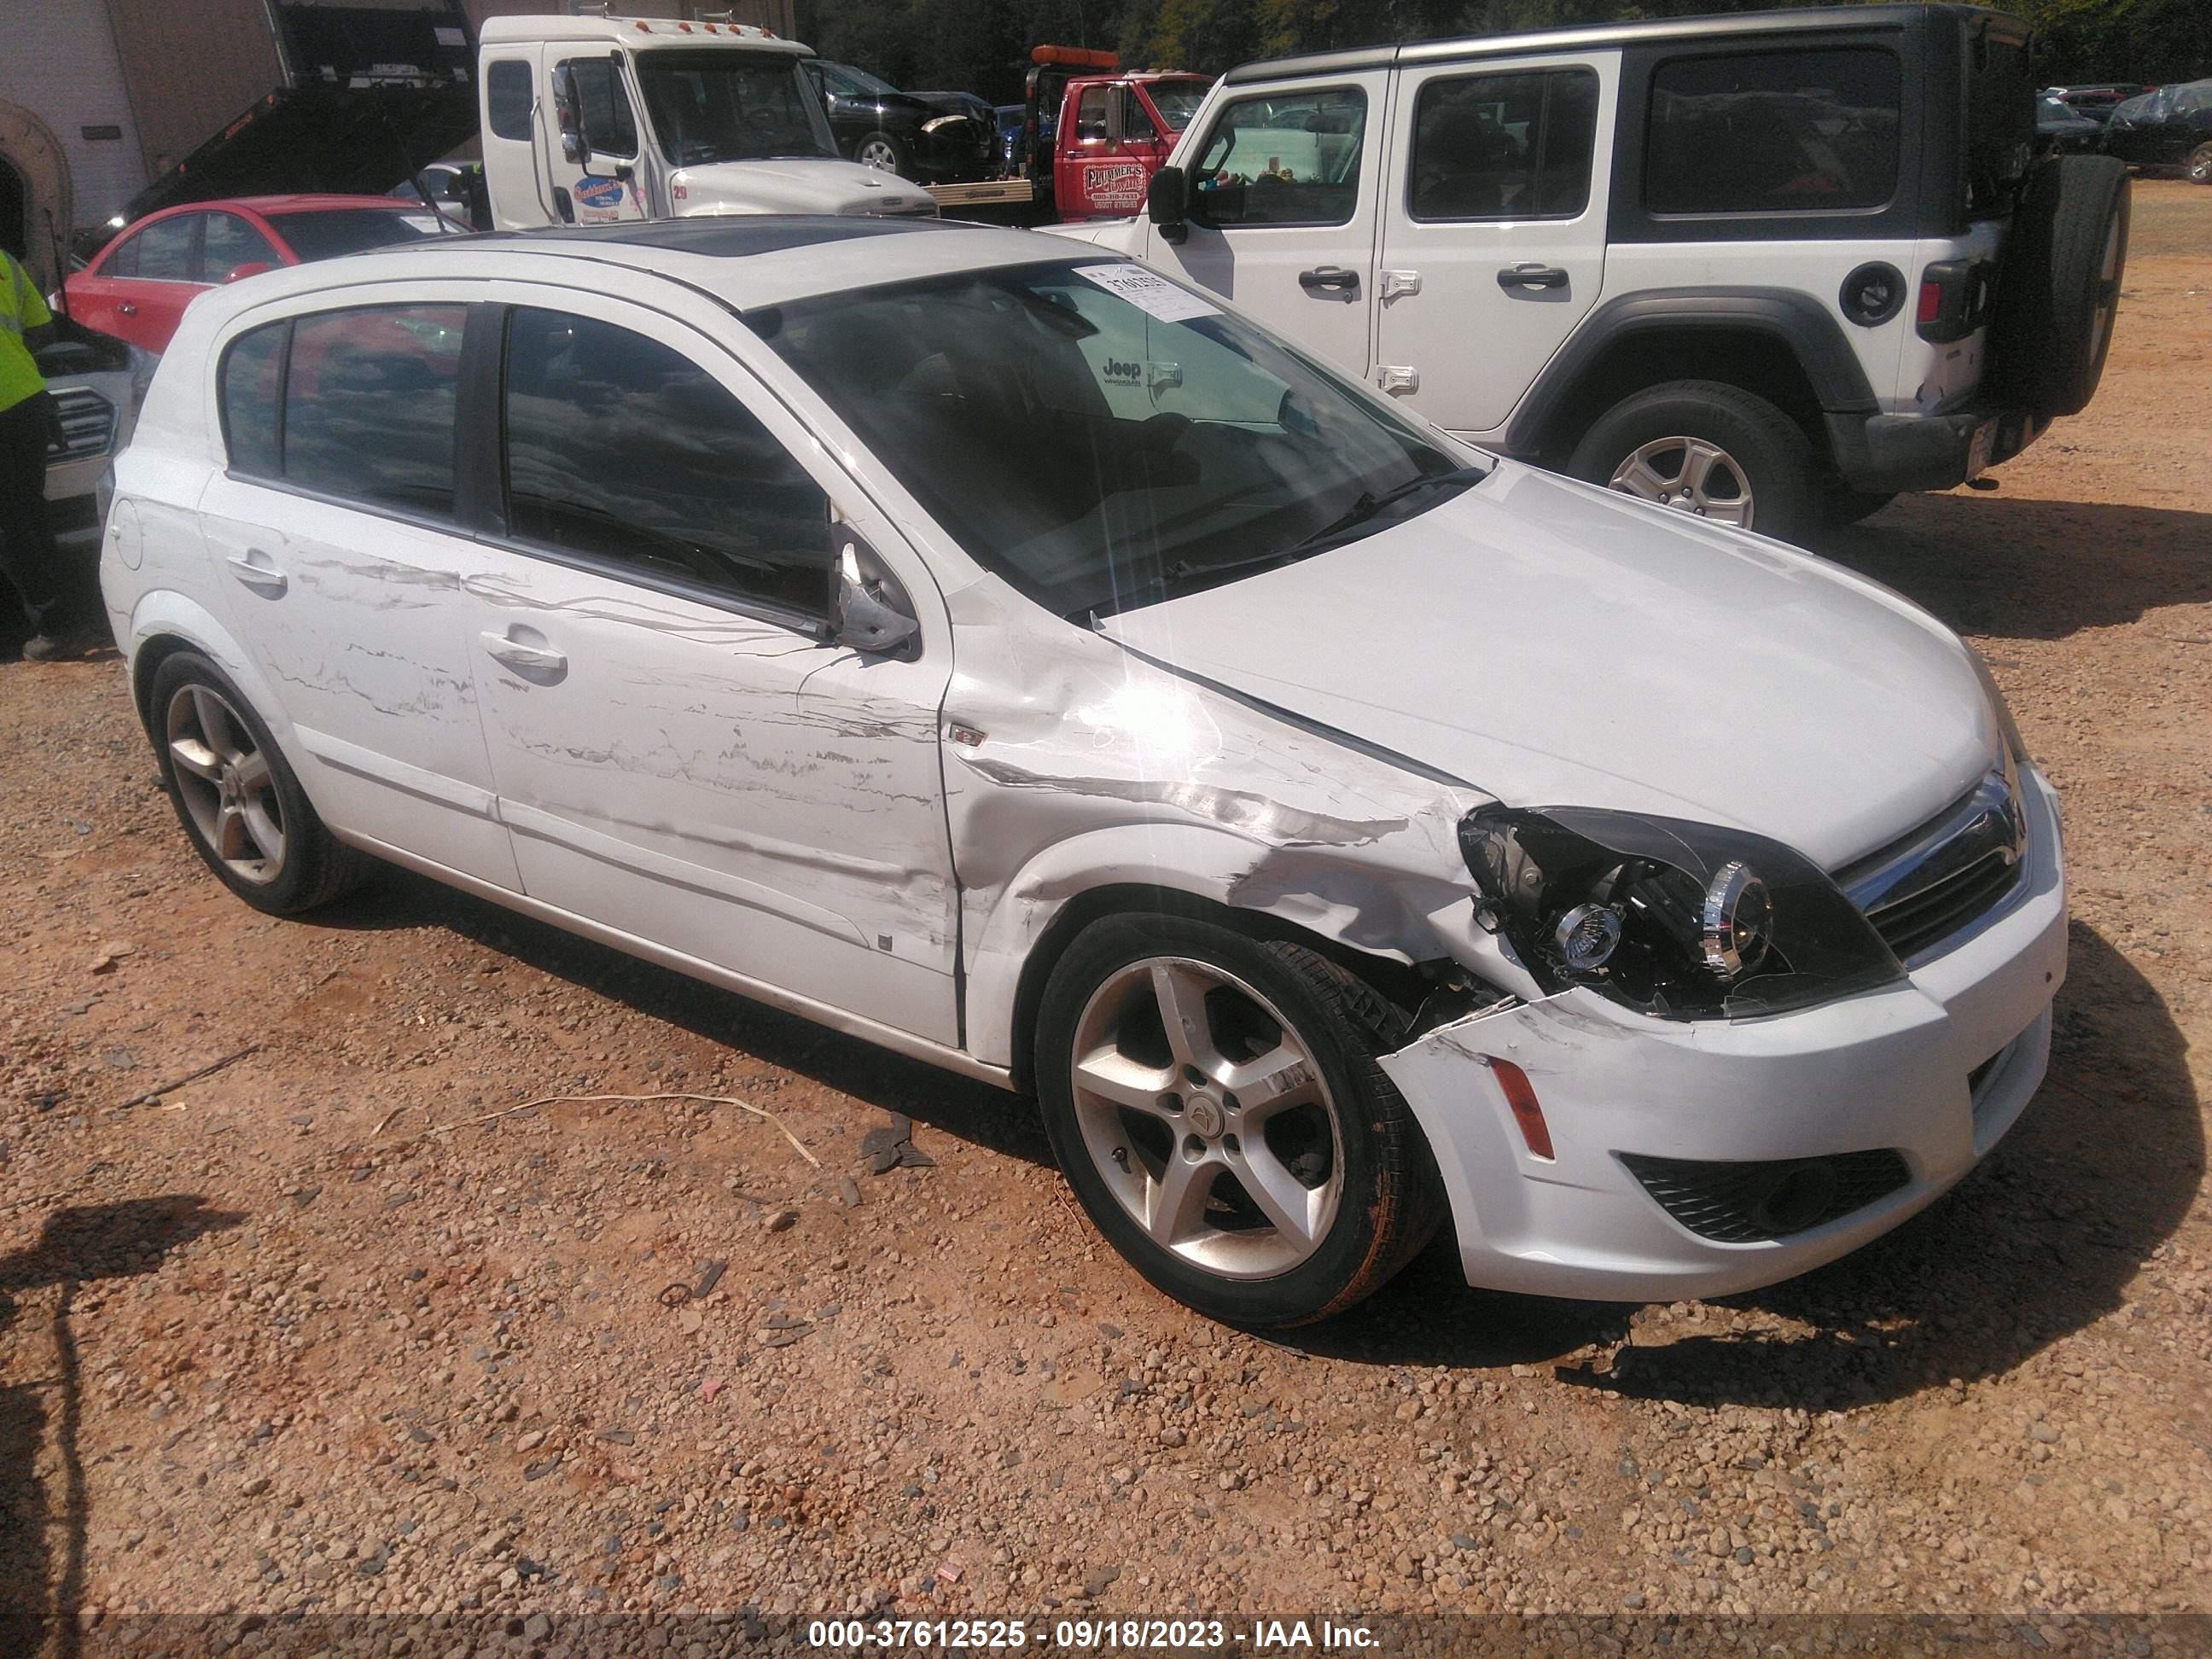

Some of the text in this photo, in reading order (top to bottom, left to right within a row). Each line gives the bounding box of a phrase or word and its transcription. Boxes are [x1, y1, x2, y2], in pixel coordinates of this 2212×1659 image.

[1087, 166, 1143, 189] PLUMMER'S
[1103, 178, 1143, 192] Towing
[673, 185, 687, 200] 29
[1103, 358, 1141, 379] Jeep
